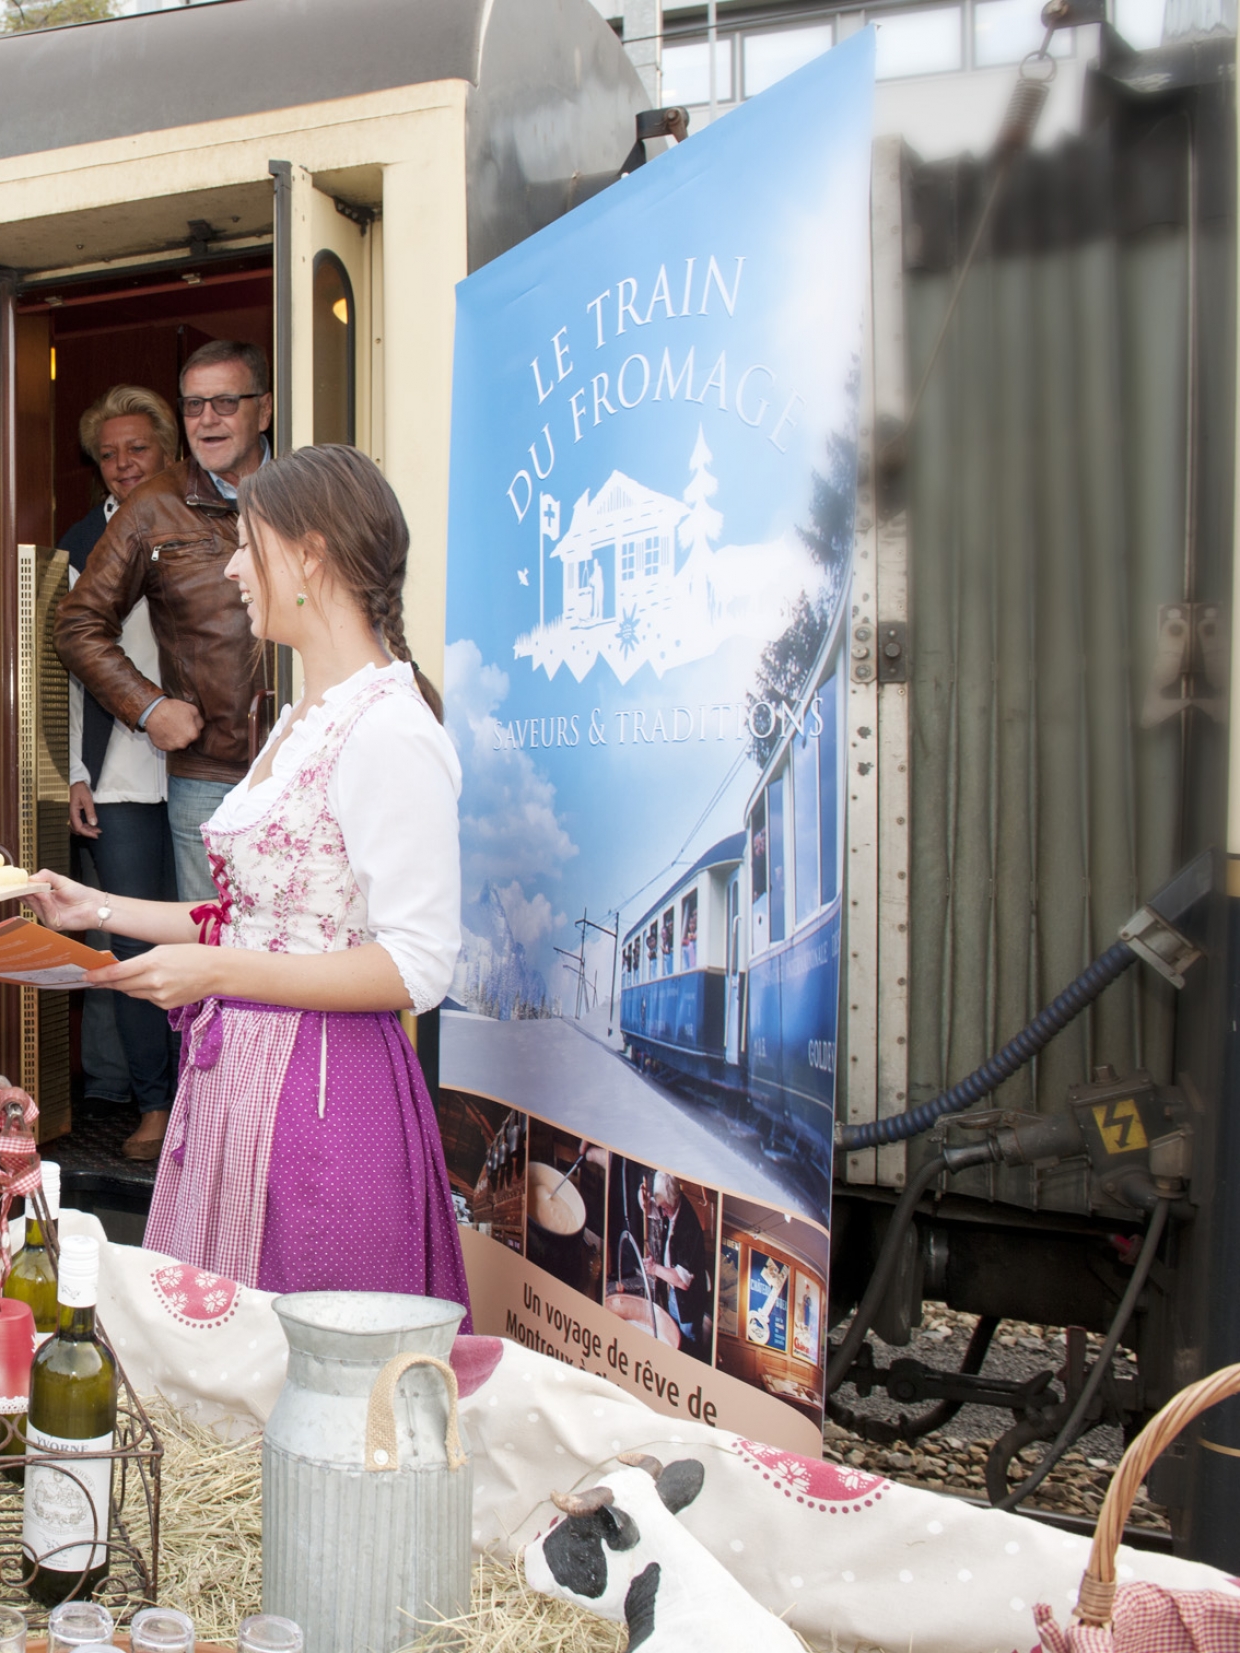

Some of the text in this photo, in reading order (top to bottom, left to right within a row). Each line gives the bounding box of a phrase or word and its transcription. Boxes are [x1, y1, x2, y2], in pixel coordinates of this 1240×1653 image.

[529, 255, 747, 405] LE TRAIN
[505, 345, 808, 525] DU FROMAGE
[492, 697, 824, 751] SAVEURS & TRADITIONS
[523, 1282, 541, 1317] Un
[545, 1301, 602, 1358] voyage
[607, 1337, 629, 1376] de
[634, 1359, 680, 1407] rêve
[687, 1385, 718, 1428] de
[36, 1435, 89, 1453] YVORNE
